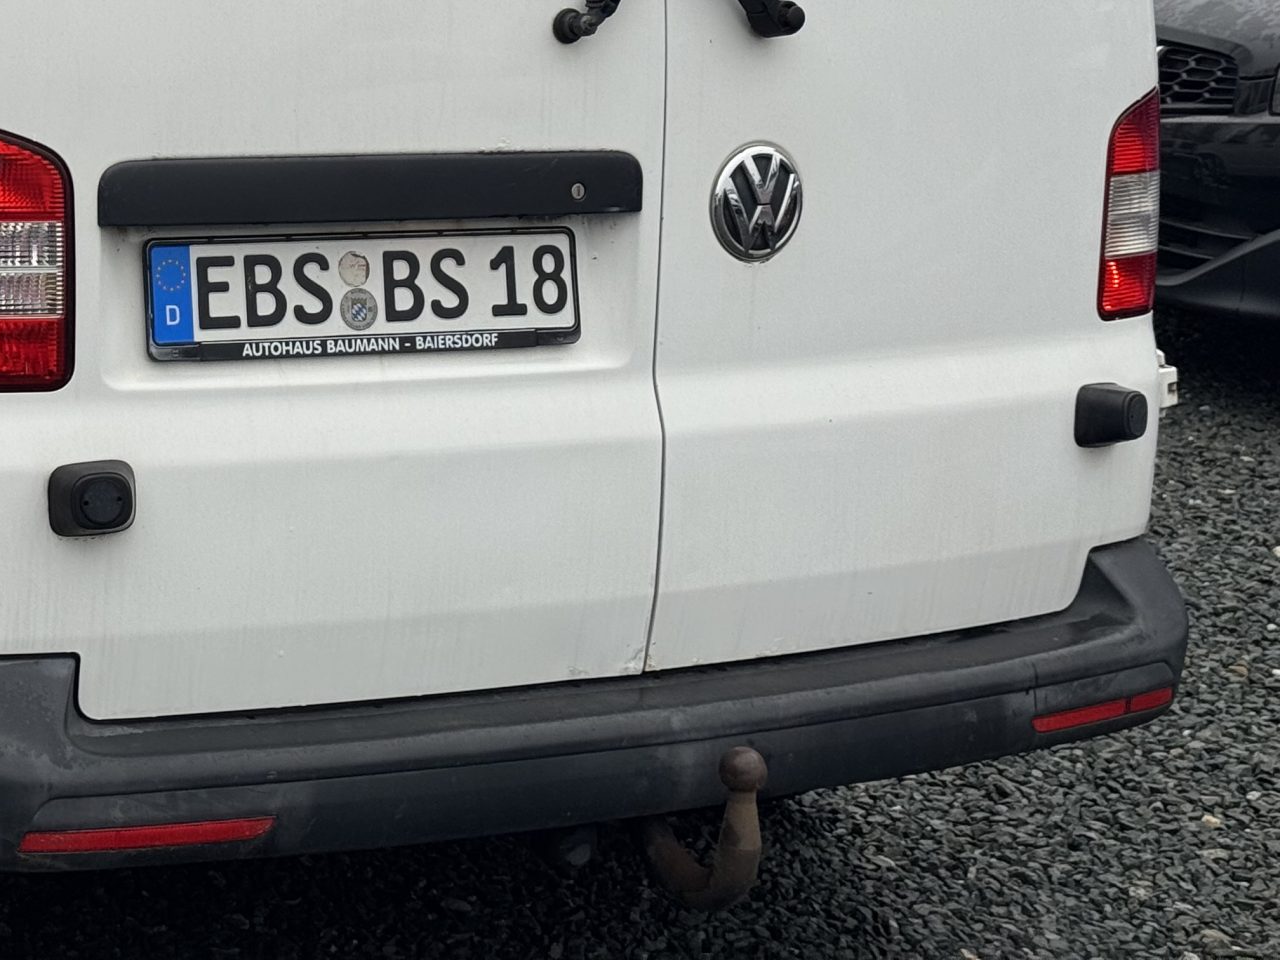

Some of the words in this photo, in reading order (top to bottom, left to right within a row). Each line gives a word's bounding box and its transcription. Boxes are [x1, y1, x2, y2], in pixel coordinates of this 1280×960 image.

[196, 252, 333, 330] EBS
[382, 248, 469, 322] BS
[489, 244, 568, 317] 18
[165, 304, 181, 326] D
[242, 340, 322, 357] AUTOHAUS
[326, 337, 400, 354] BAUMANN
[415, 333, 499, 350] BAIERSDORF
